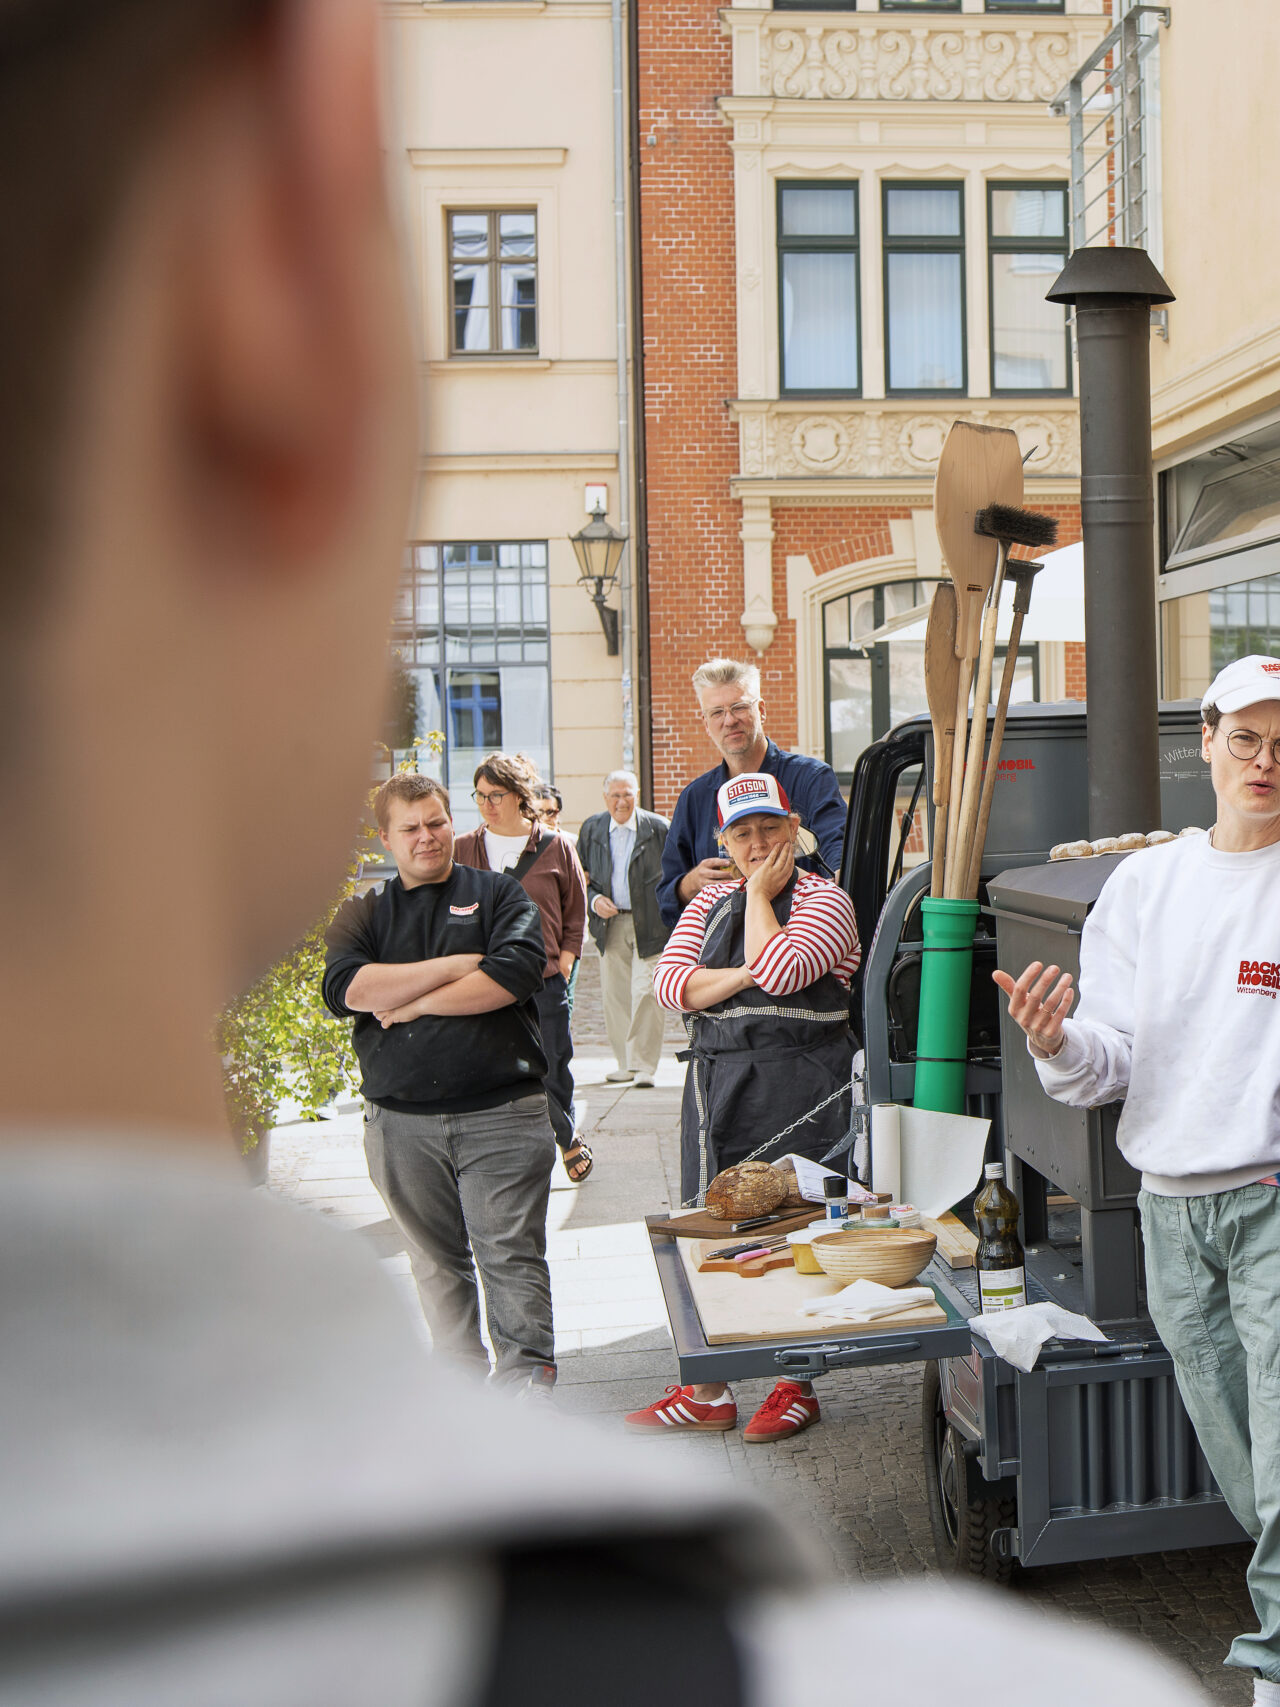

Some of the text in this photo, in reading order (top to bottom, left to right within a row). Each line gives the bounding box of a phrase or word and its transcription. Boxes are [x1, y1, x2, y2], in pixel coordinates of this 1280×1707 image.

[1163, 747, 1201, 763] Witten
[728, 780, 765, 798] STETSON
[1240, 960, 1280, 976] BACK
[1236, 986, 1277, 999] Wittenberg
